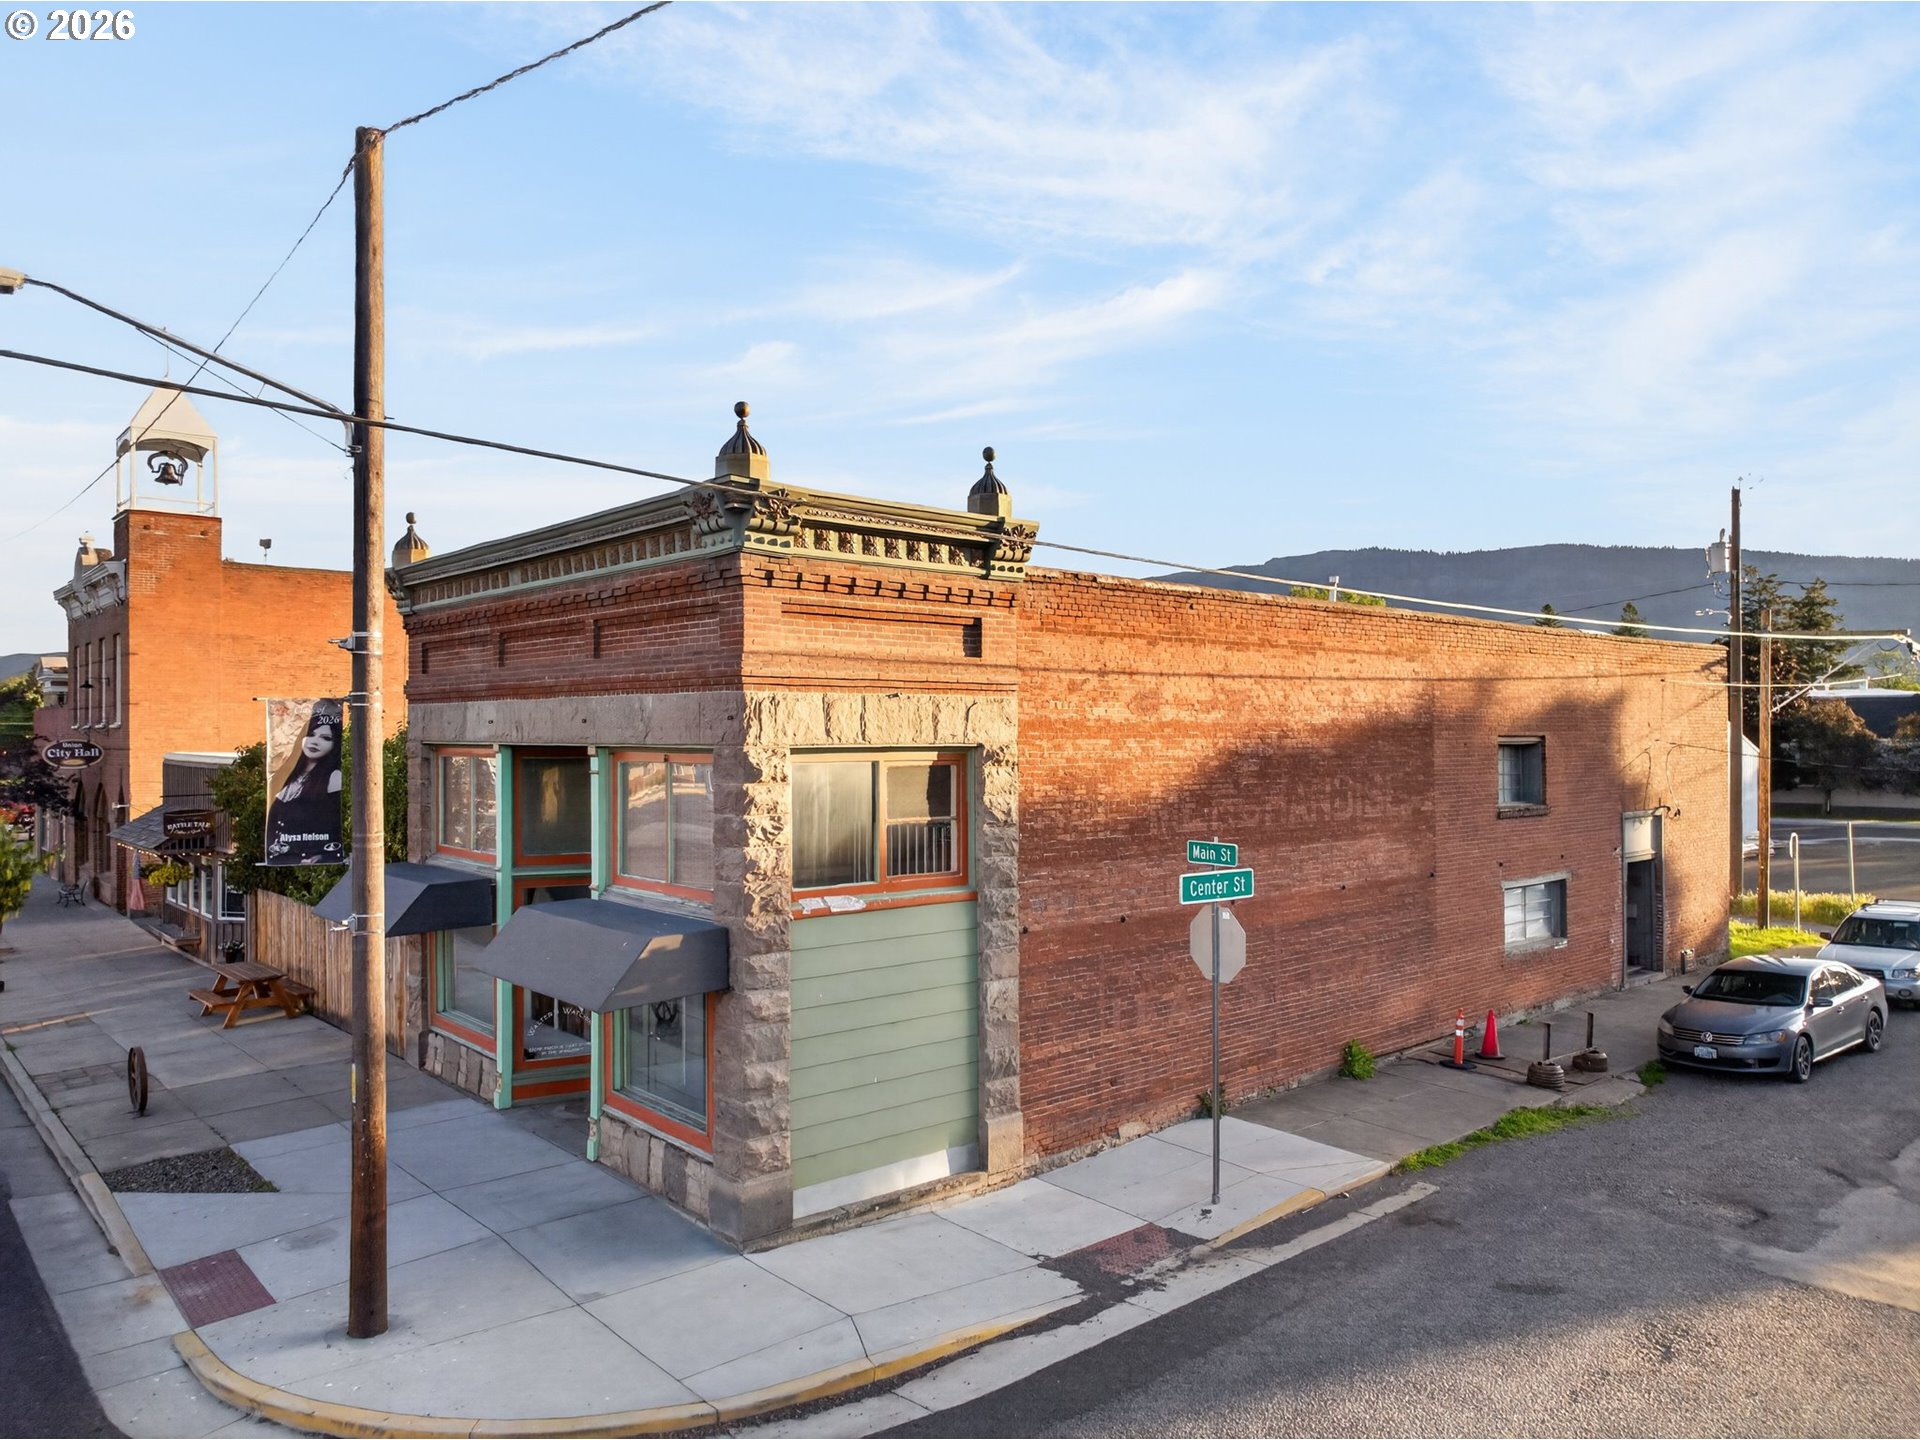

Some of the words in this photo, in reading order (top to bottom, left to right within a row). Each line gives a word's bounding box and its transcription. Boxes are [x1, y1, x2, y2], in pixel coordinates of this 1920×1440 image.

[317, 715, 340, 725] 2026
[47, 749, 71, 760] City
[75, 748, 99, 757] Hall
[280, 833, 301, 842] Alysa
[302, 832, 329, 841] Nelson
[1192, 845, 1216, 861] Main
[1220, 848, 1231, 862] St
[1190, 879, 1229, 897] Center
[1233, 876, 1245, 893] St
